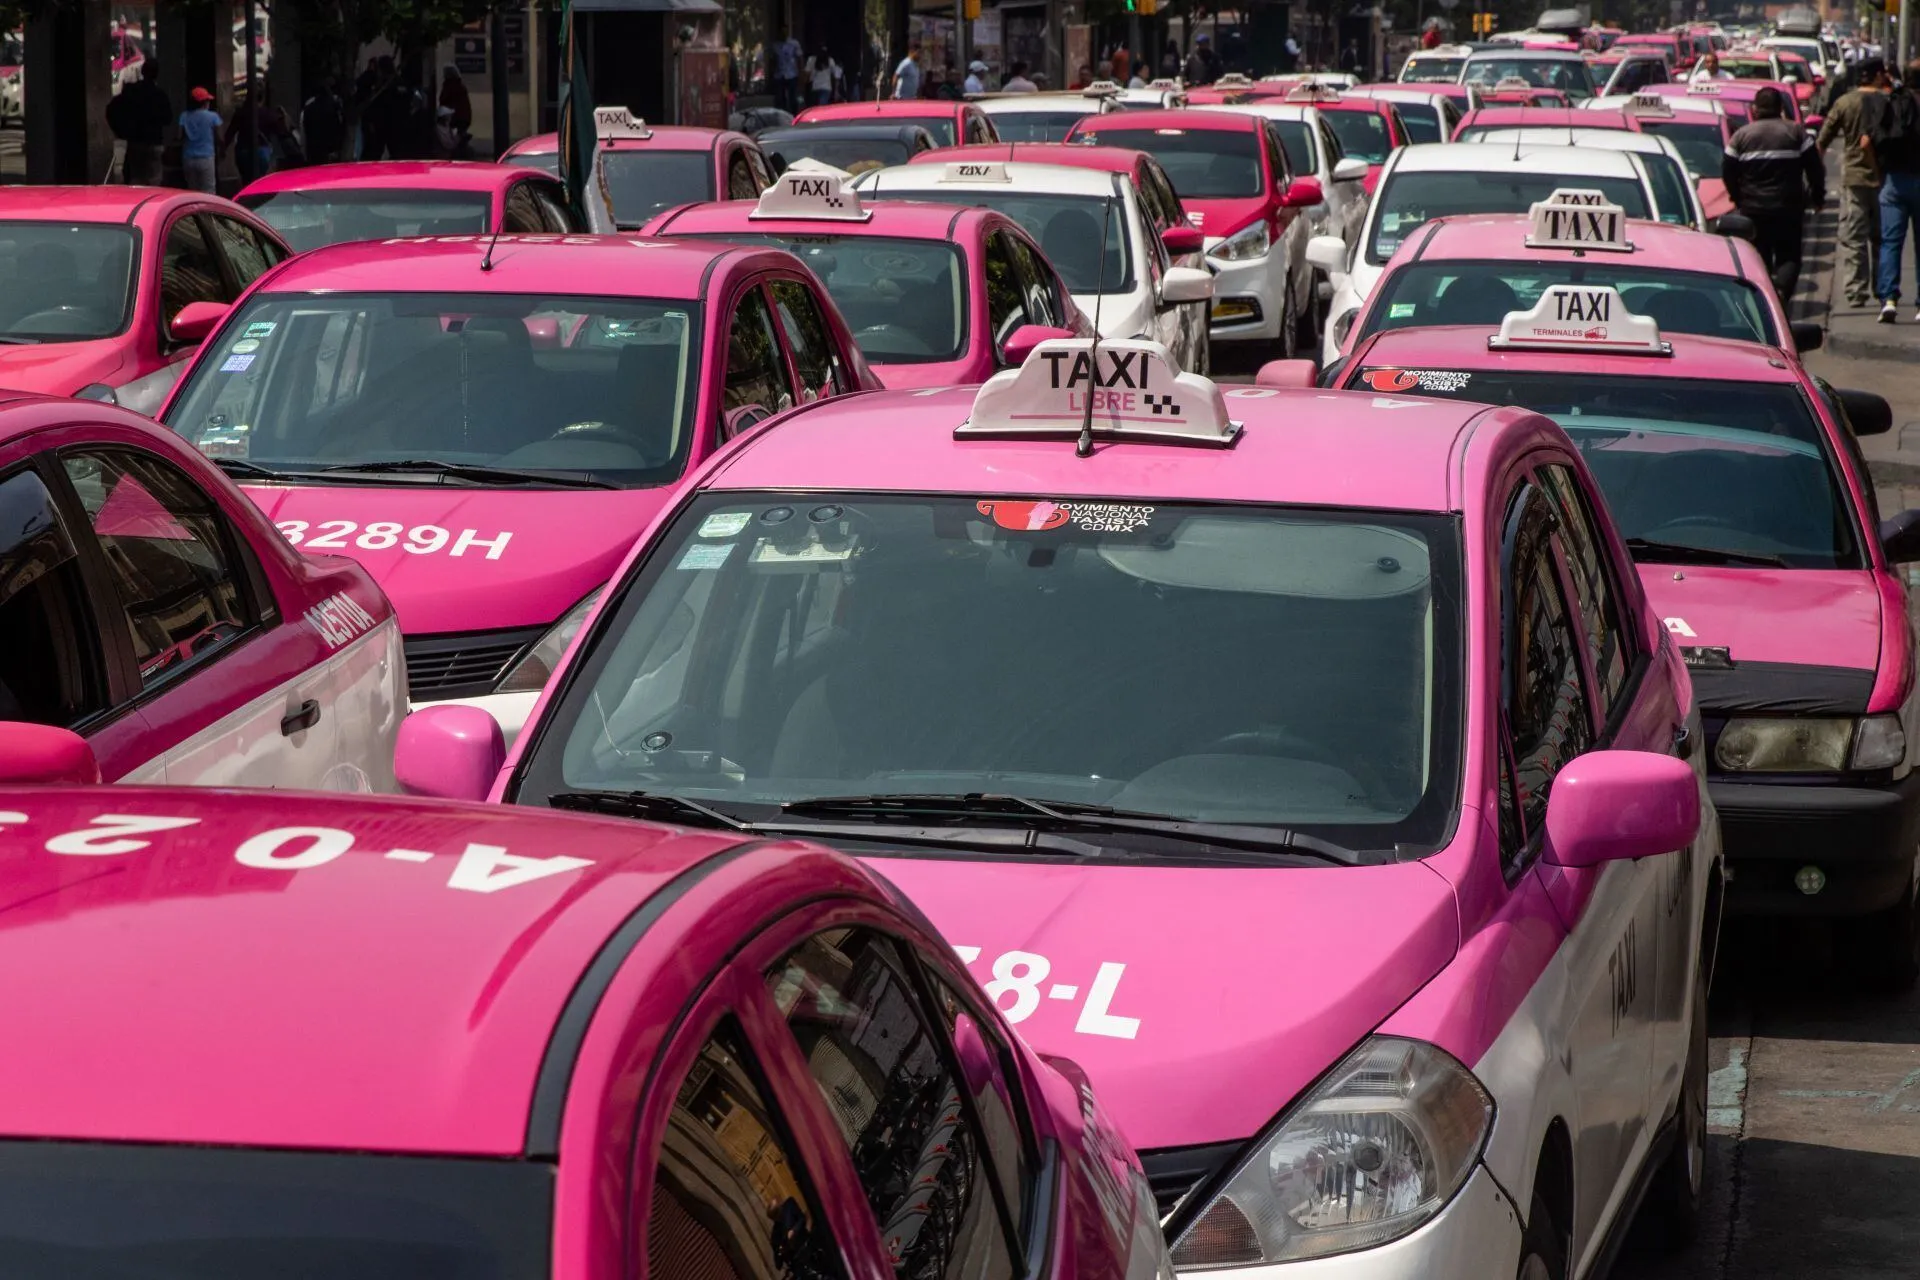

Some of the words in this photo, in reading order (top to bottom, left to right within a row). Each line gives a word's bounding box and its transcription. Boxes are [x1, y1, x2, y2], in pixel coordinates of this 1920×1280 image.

[1636, 96, 1660, 107] TAXI
[598, 112, 627, 124] TAXI
[959, 165, 990, 176] TAXI
[789, 180, 829, 197] TAXI
[1559, 194, 1601, 205] TAXI
[1544, 210, 1617, 242] TAXI
[1553, 291, 1610, 322] TAXI
[1533, 328, 1583, 337] TERMINALES
[1041, 350, 1149, 389] TAXI
[1404, 370, 1471, 378] MOVIMIENTO
[1419, 375, 1468, 383] NACIONAL
[1069, 391, 1136, 412] LIBRE
[1071, 510, 1152, 520] NACIONAL
[1071, 516, 1148, 526] TAXISTA
[1081, 524, 1133, 532] CDMX
[302, 590, 376, 650] A2570A
[0, 811, 597, 893] A-02
[1608, 915, 1636, 1040] TAXI
[952, 945, 1141, 1039] 8-L
